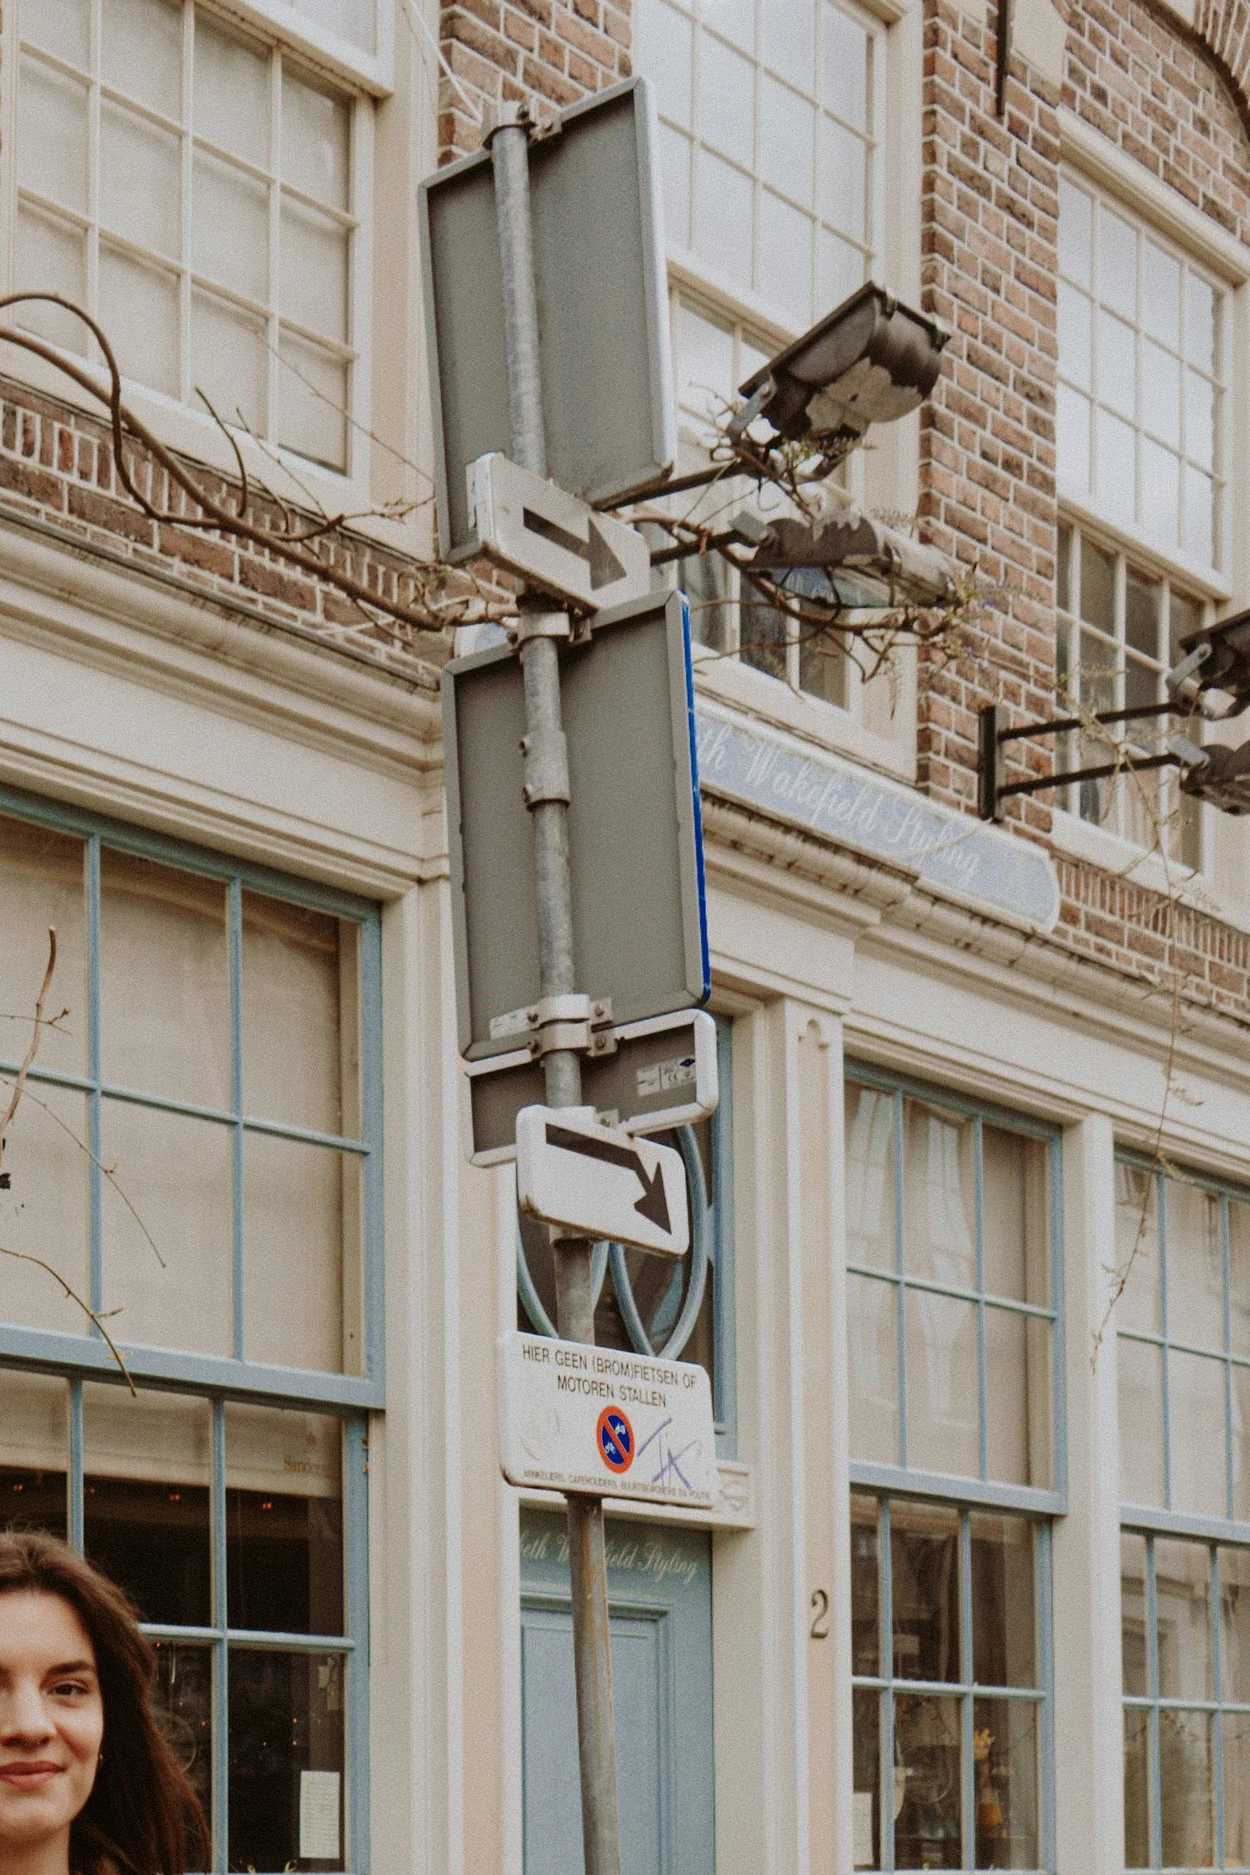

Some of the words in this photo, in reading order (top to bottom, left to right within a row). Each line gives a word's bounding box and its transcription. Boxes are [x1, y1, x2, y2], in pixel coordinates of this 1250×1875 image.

[744, 743, 881, 828] Wakefield
[882, 797, 981, 887] Styling
[522, 1344, 550, 1364] HIER
[555, 1350, 587, 1371] GEEN
[592, 1355, 679, 1387] (BROM)FIETSEN
[683, 1373, 697, 1389] OF
[557, 1375, 615, 1400] MOTOREN
[619, 1385, 666, 1408] STALLEN
[639, 1541, 699, 1585] Styling
[809, 1589, 831, 1640] 2
